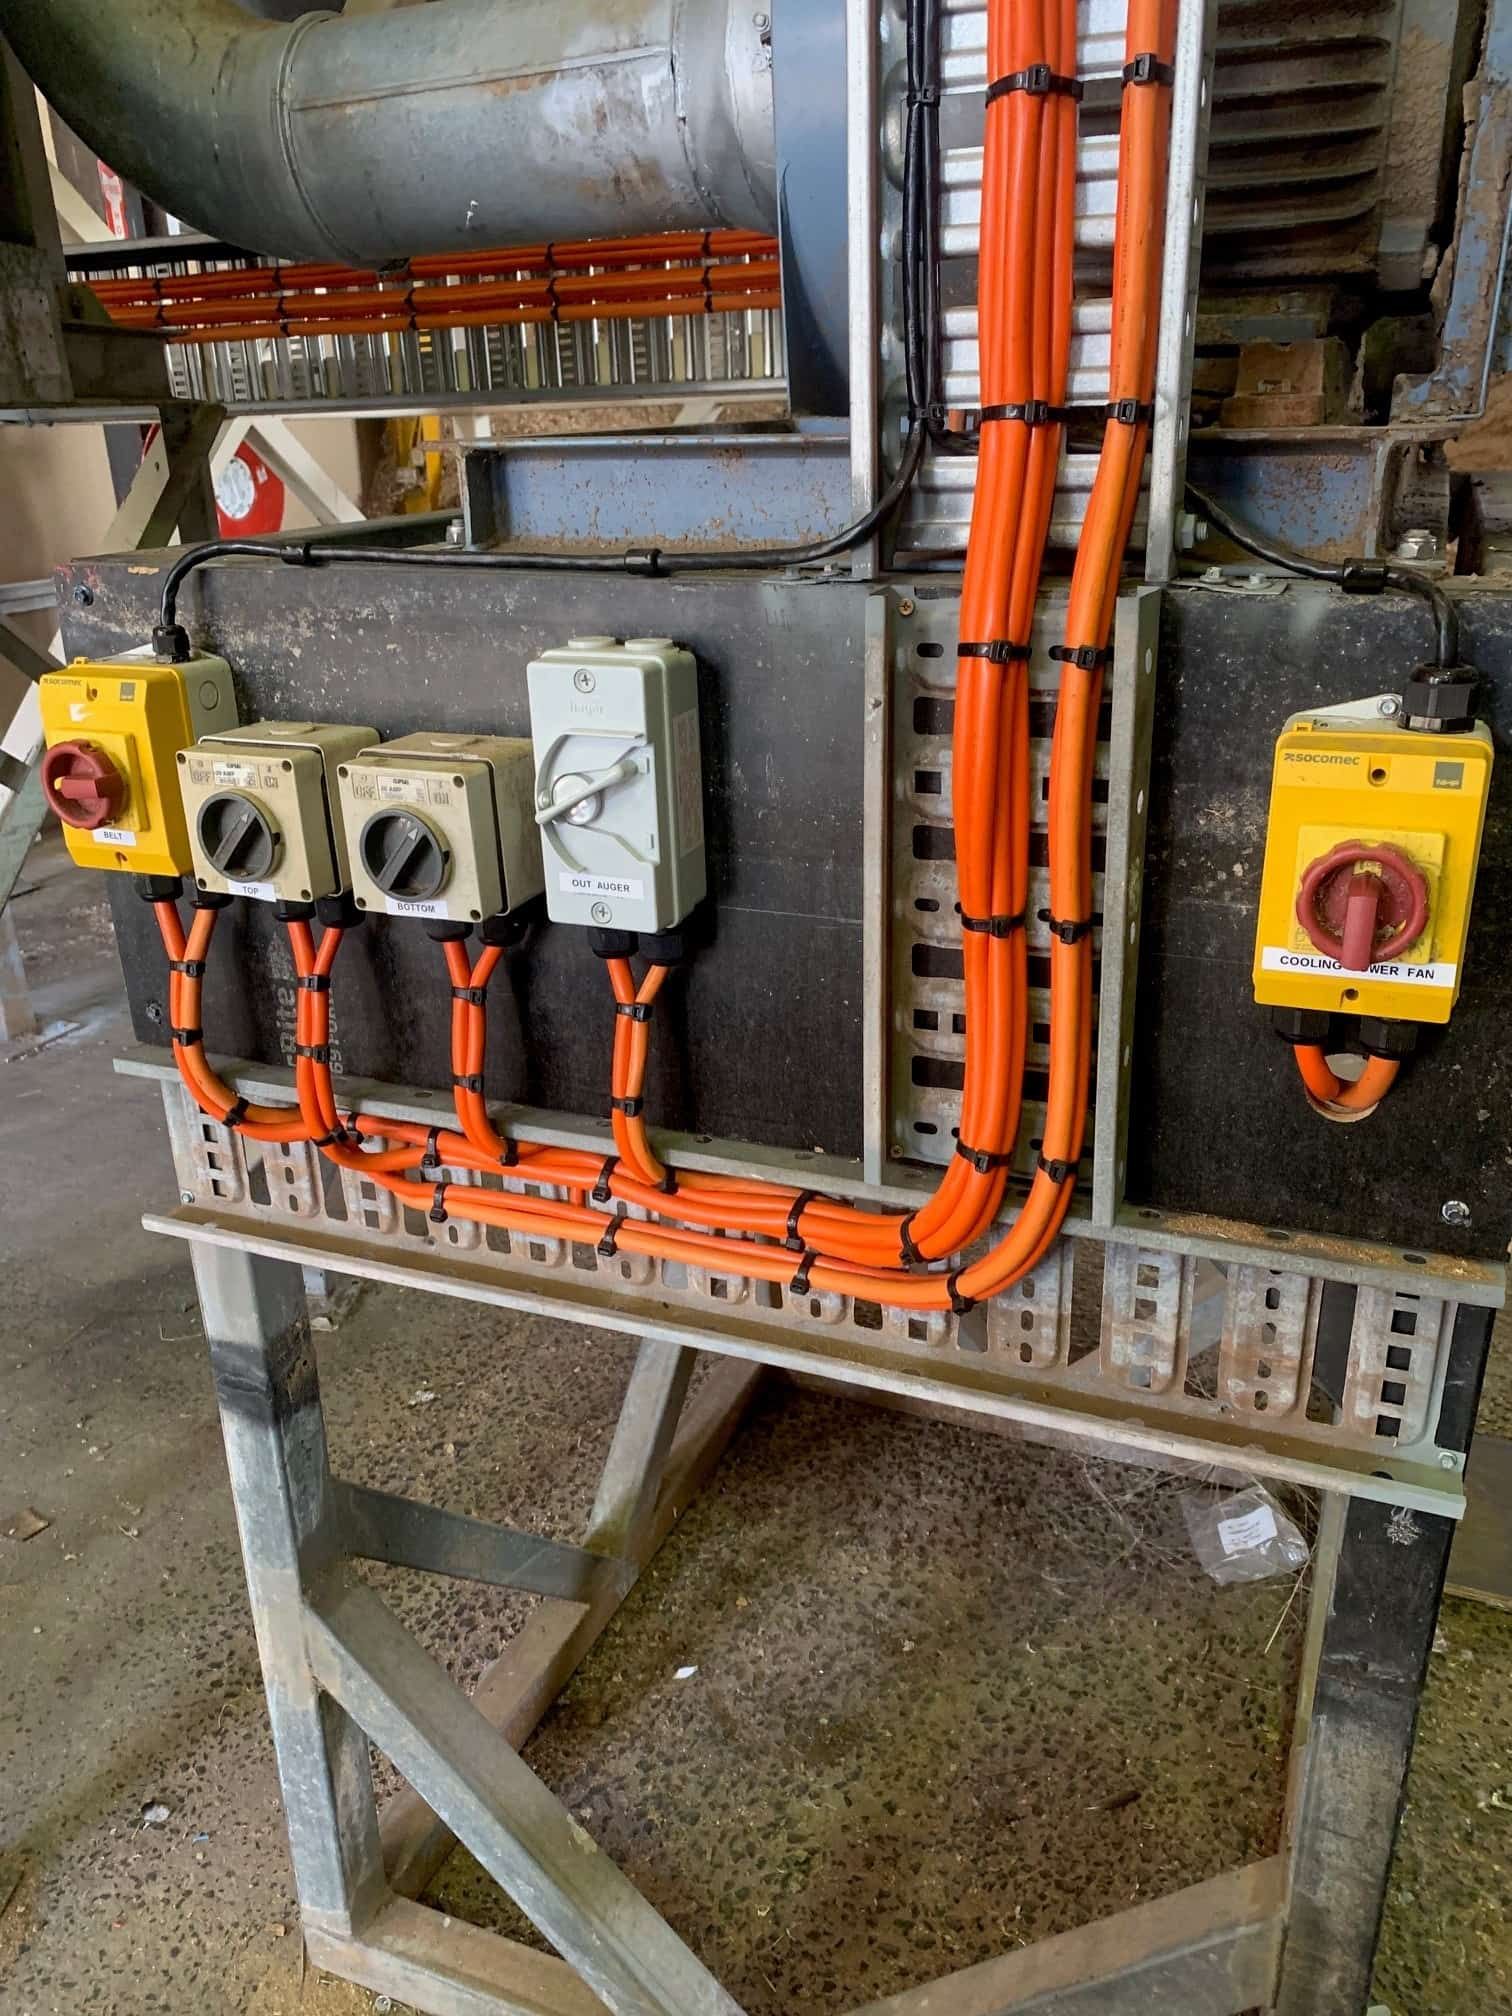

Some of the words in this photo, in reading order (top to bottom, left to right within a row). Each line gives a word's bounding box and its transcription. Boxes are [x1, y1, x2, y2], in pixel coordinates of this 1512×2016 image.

[1295, 752, 1361, 766] socomec
[103, 830, 123, 841] BELT
[242, 886, 259, 895] TOP
[571, 878, 592, 890] OUT
[596, 880, 631, 893] AUGER
[397, 902, 436, 913] BOTTOM
[1280, 955, 1342, 970] COOLING
[1408, 967, 1435, 980] FAN
